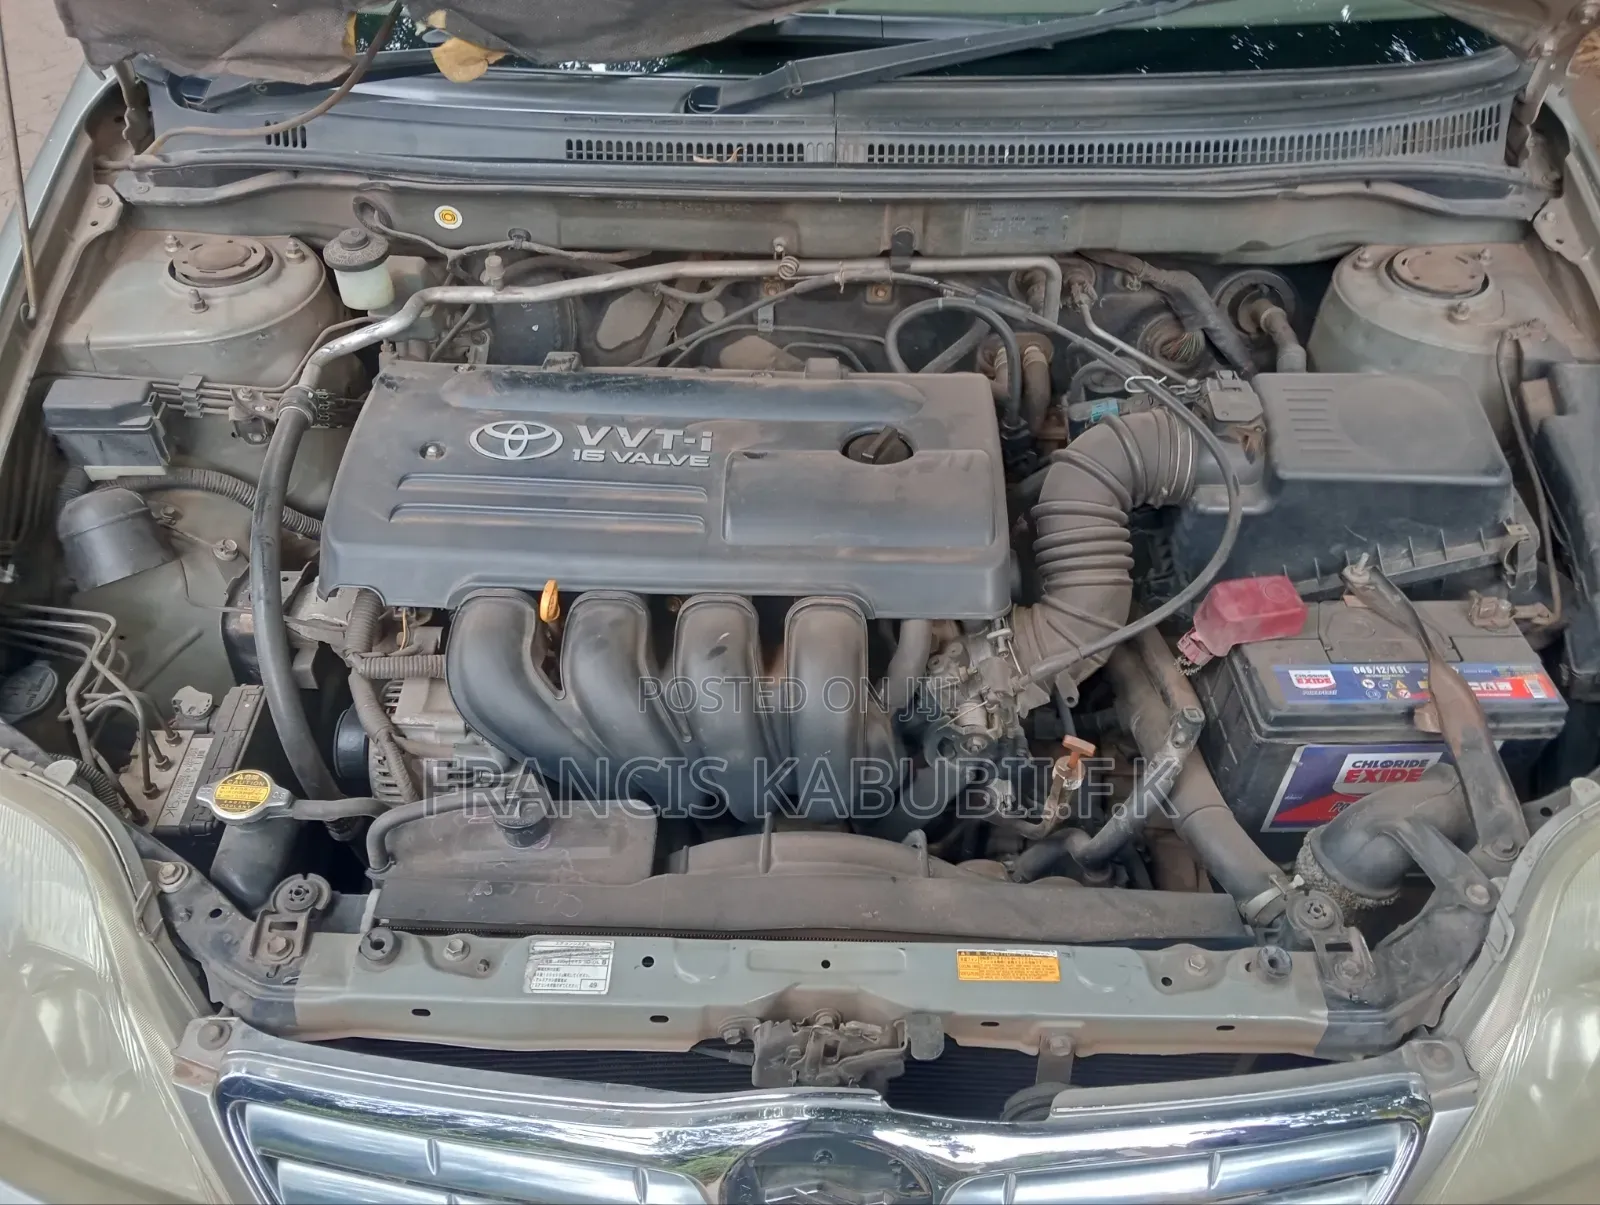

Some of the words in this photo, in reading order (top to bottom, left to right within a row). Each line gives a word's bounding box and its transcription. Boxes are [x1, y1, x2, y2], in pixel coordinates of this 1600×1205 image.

[576, 425, 713, 452] VVT-i
[572, 448, 606, 462] 16
[611, 451, 710, 467] VALVE
[1297, 677, 1332, 685] EXIDE
[1351, 759, 1430, 769] CHLORIDE
[1343, 768, 1425, 783] EXIDE
